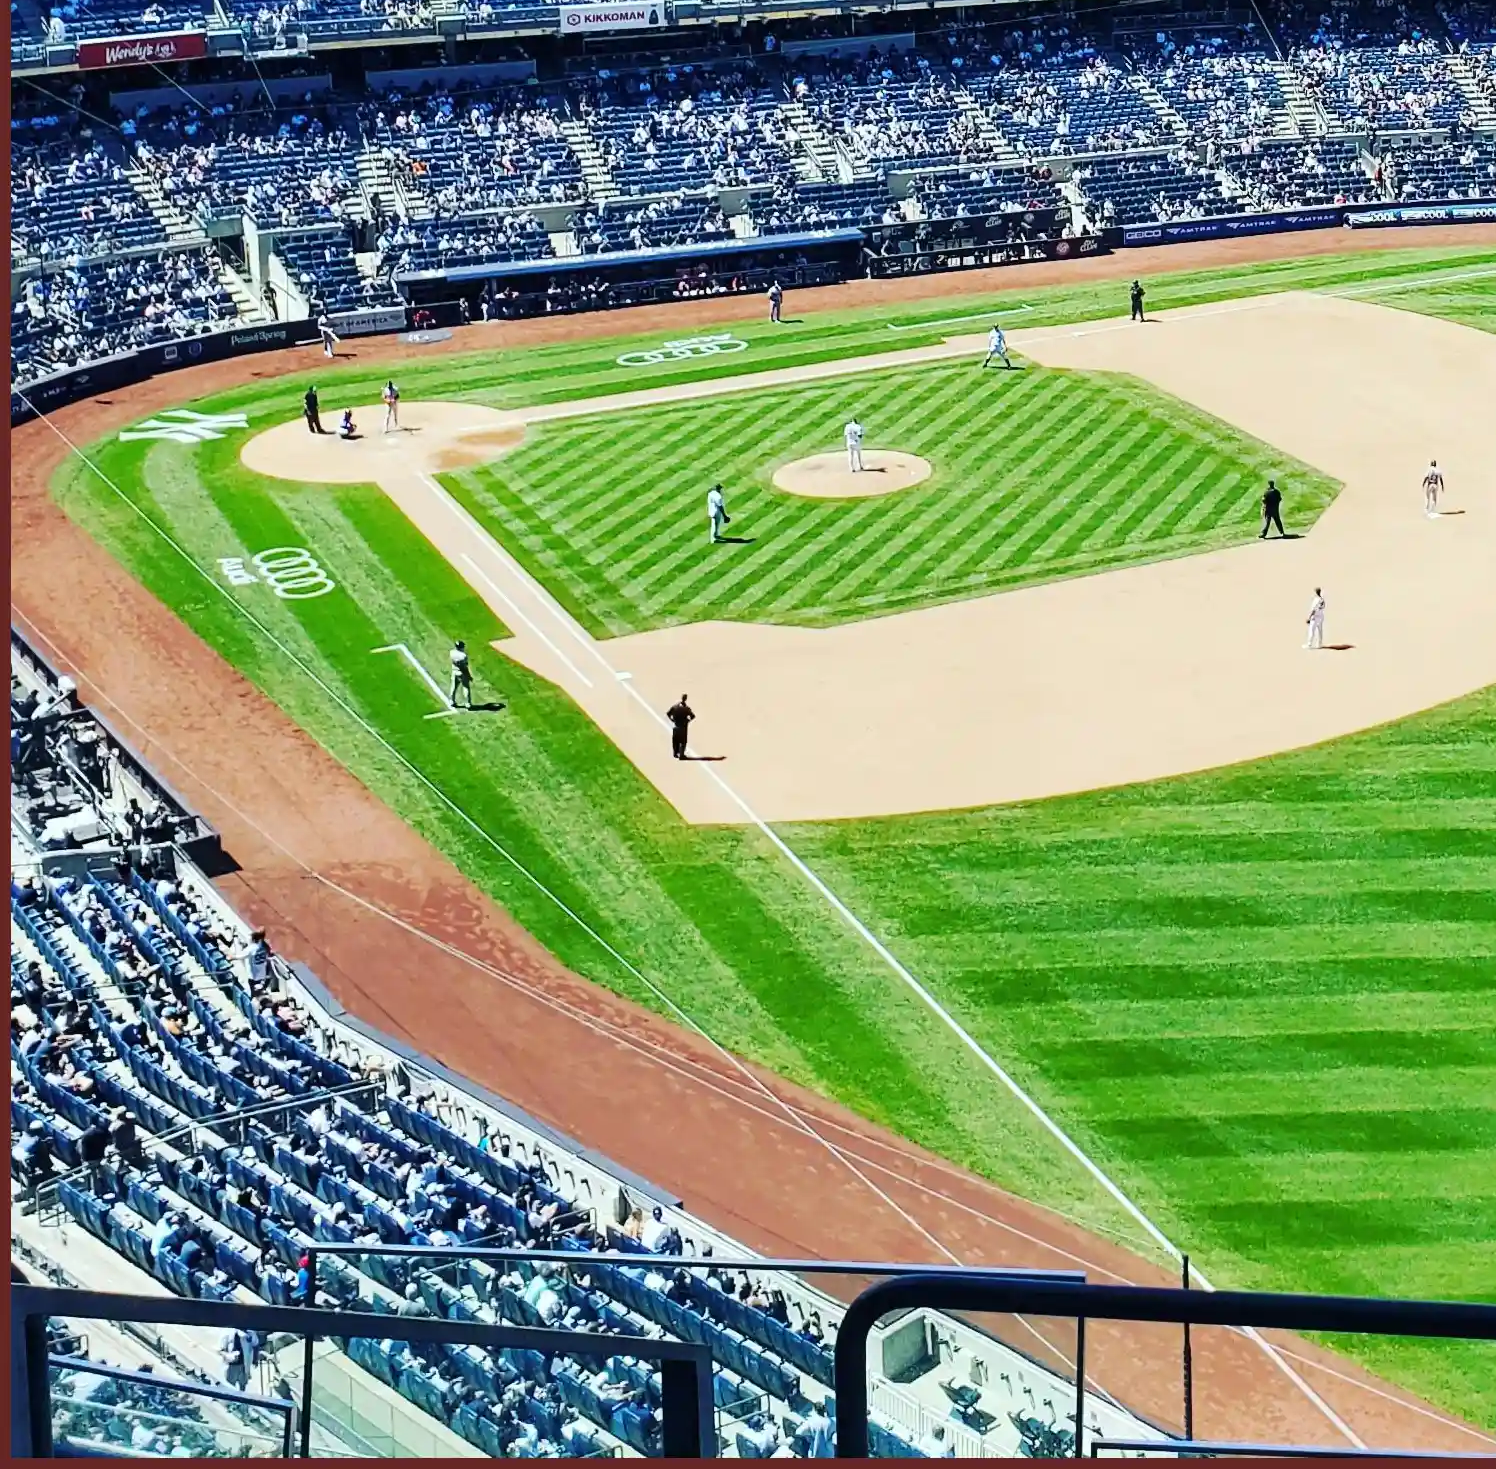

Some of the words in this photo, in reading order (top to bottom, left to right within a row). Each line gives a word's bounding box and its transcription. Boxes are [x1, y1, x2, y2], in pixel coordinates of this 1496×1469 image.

[584, 11, 645, 23] KIKKOMAN
[105, 42, 154, 64] Wendy's
[1422, 209, 1449, 219] COOL
[1239, 220, 1277, 228] AMTRAK
[1179, 225, 1220, 234] AMTRAK
[1125, 230, 1161, 240] GEICO
